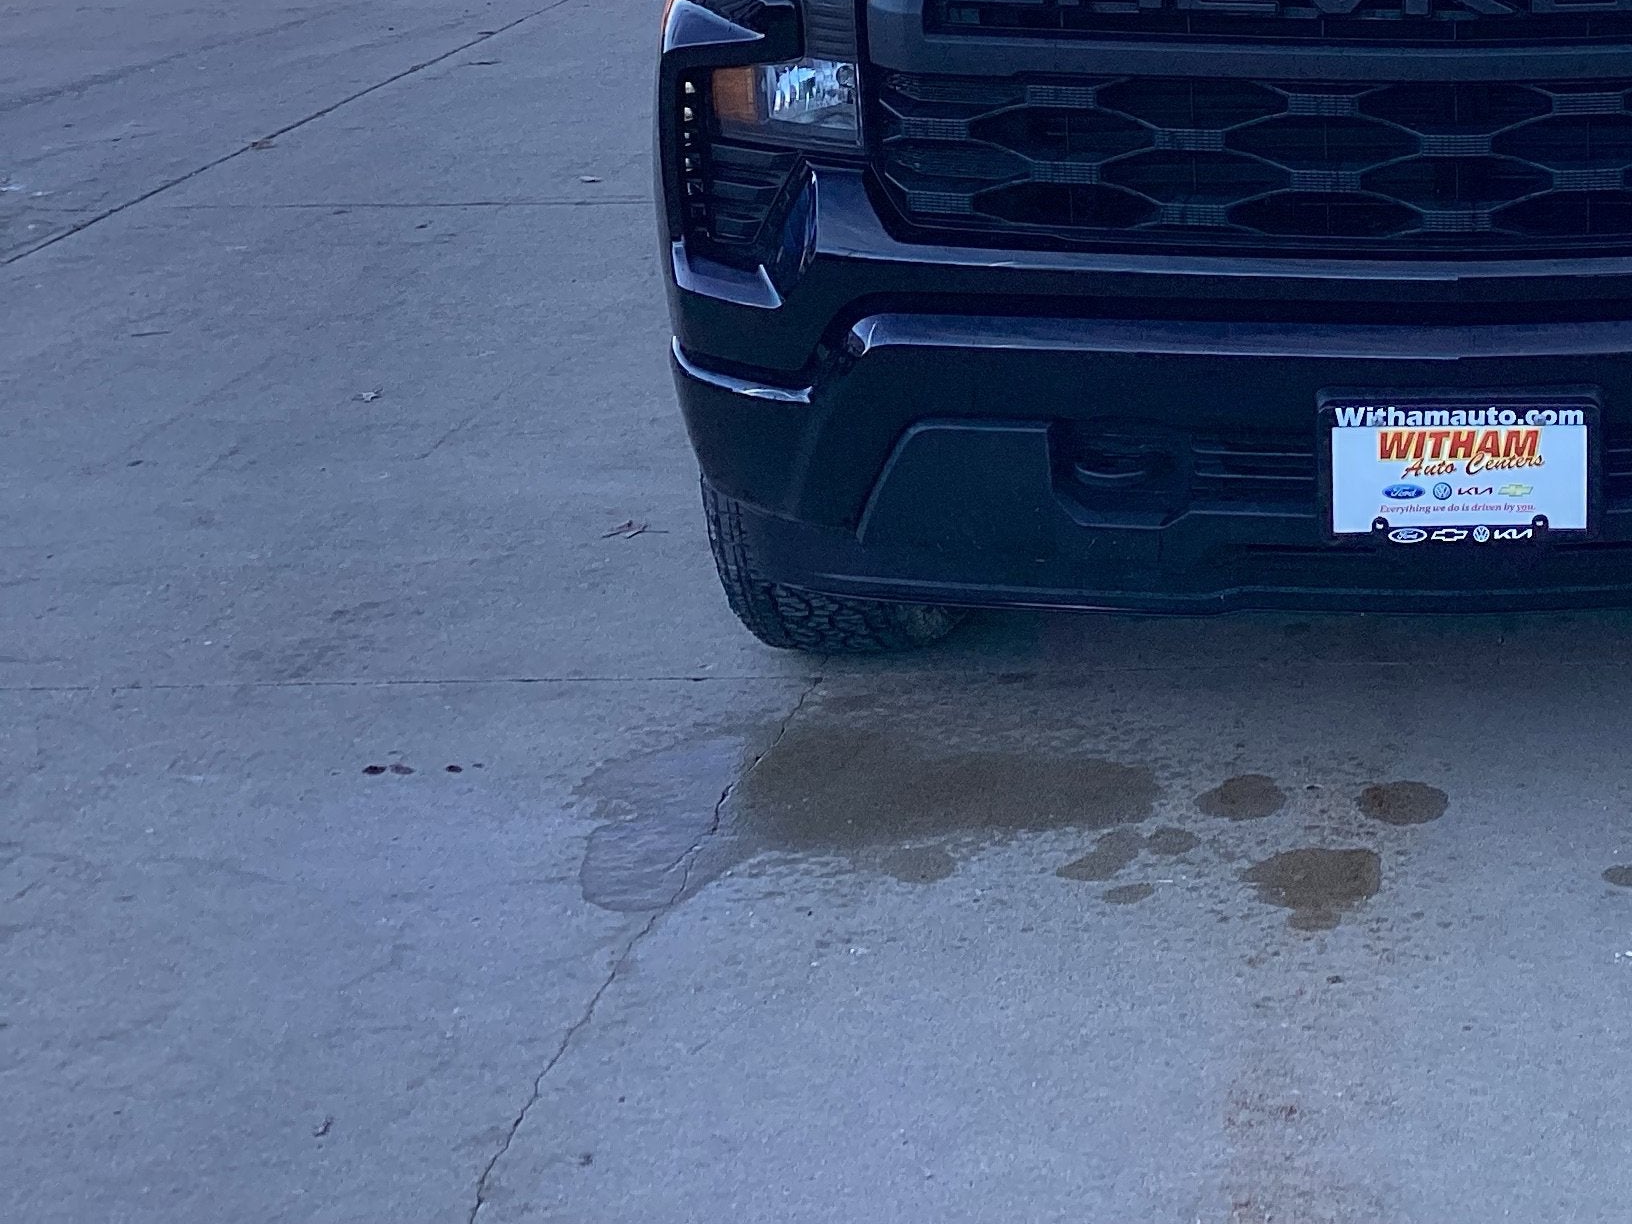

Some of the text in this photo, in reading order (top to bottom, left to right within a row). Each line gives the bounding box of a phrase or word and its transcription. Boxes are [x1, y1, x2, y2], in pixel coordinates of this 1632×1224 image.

[1335, 406, 1584, 427] Withamauto.com
[1379, 429, 1541, 460] WITHAM
[1401, 452, 1545, 480] Auto Centers
[1380, 504, 1431, 514] Everything
[1447, 503, 1460, 512] do
[1461, 504, 1470, 512] is
[1471, 503, 1501, 512] driven
[1503, 502, 1515, 513] by
